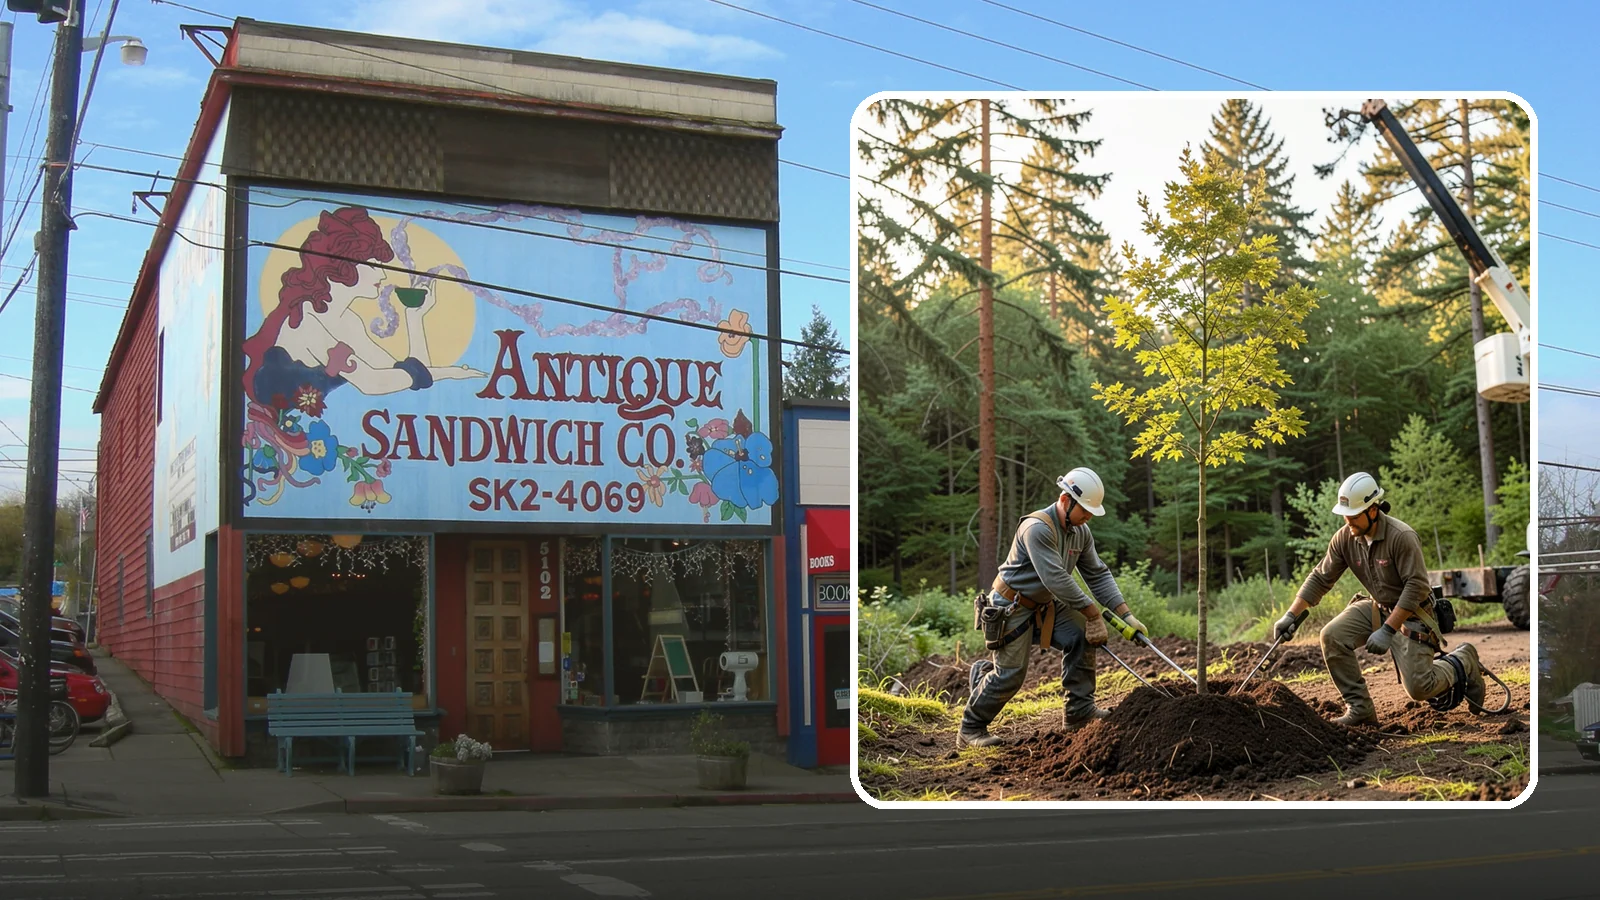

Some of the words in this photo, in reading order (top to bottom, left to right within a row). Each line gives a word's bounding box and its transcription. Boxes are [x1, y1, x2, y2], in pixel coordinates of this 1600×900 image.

[476, 329, 723, 421] ANTIQUE
[361, 408, 604, 467] SANDWICH
[617, 421, 684, 469] CO.
[469, 477, 645, 512] SK2-4069
[540, 541, 551, 599] 5102
[809, 555, 835, 569] BOOKS
